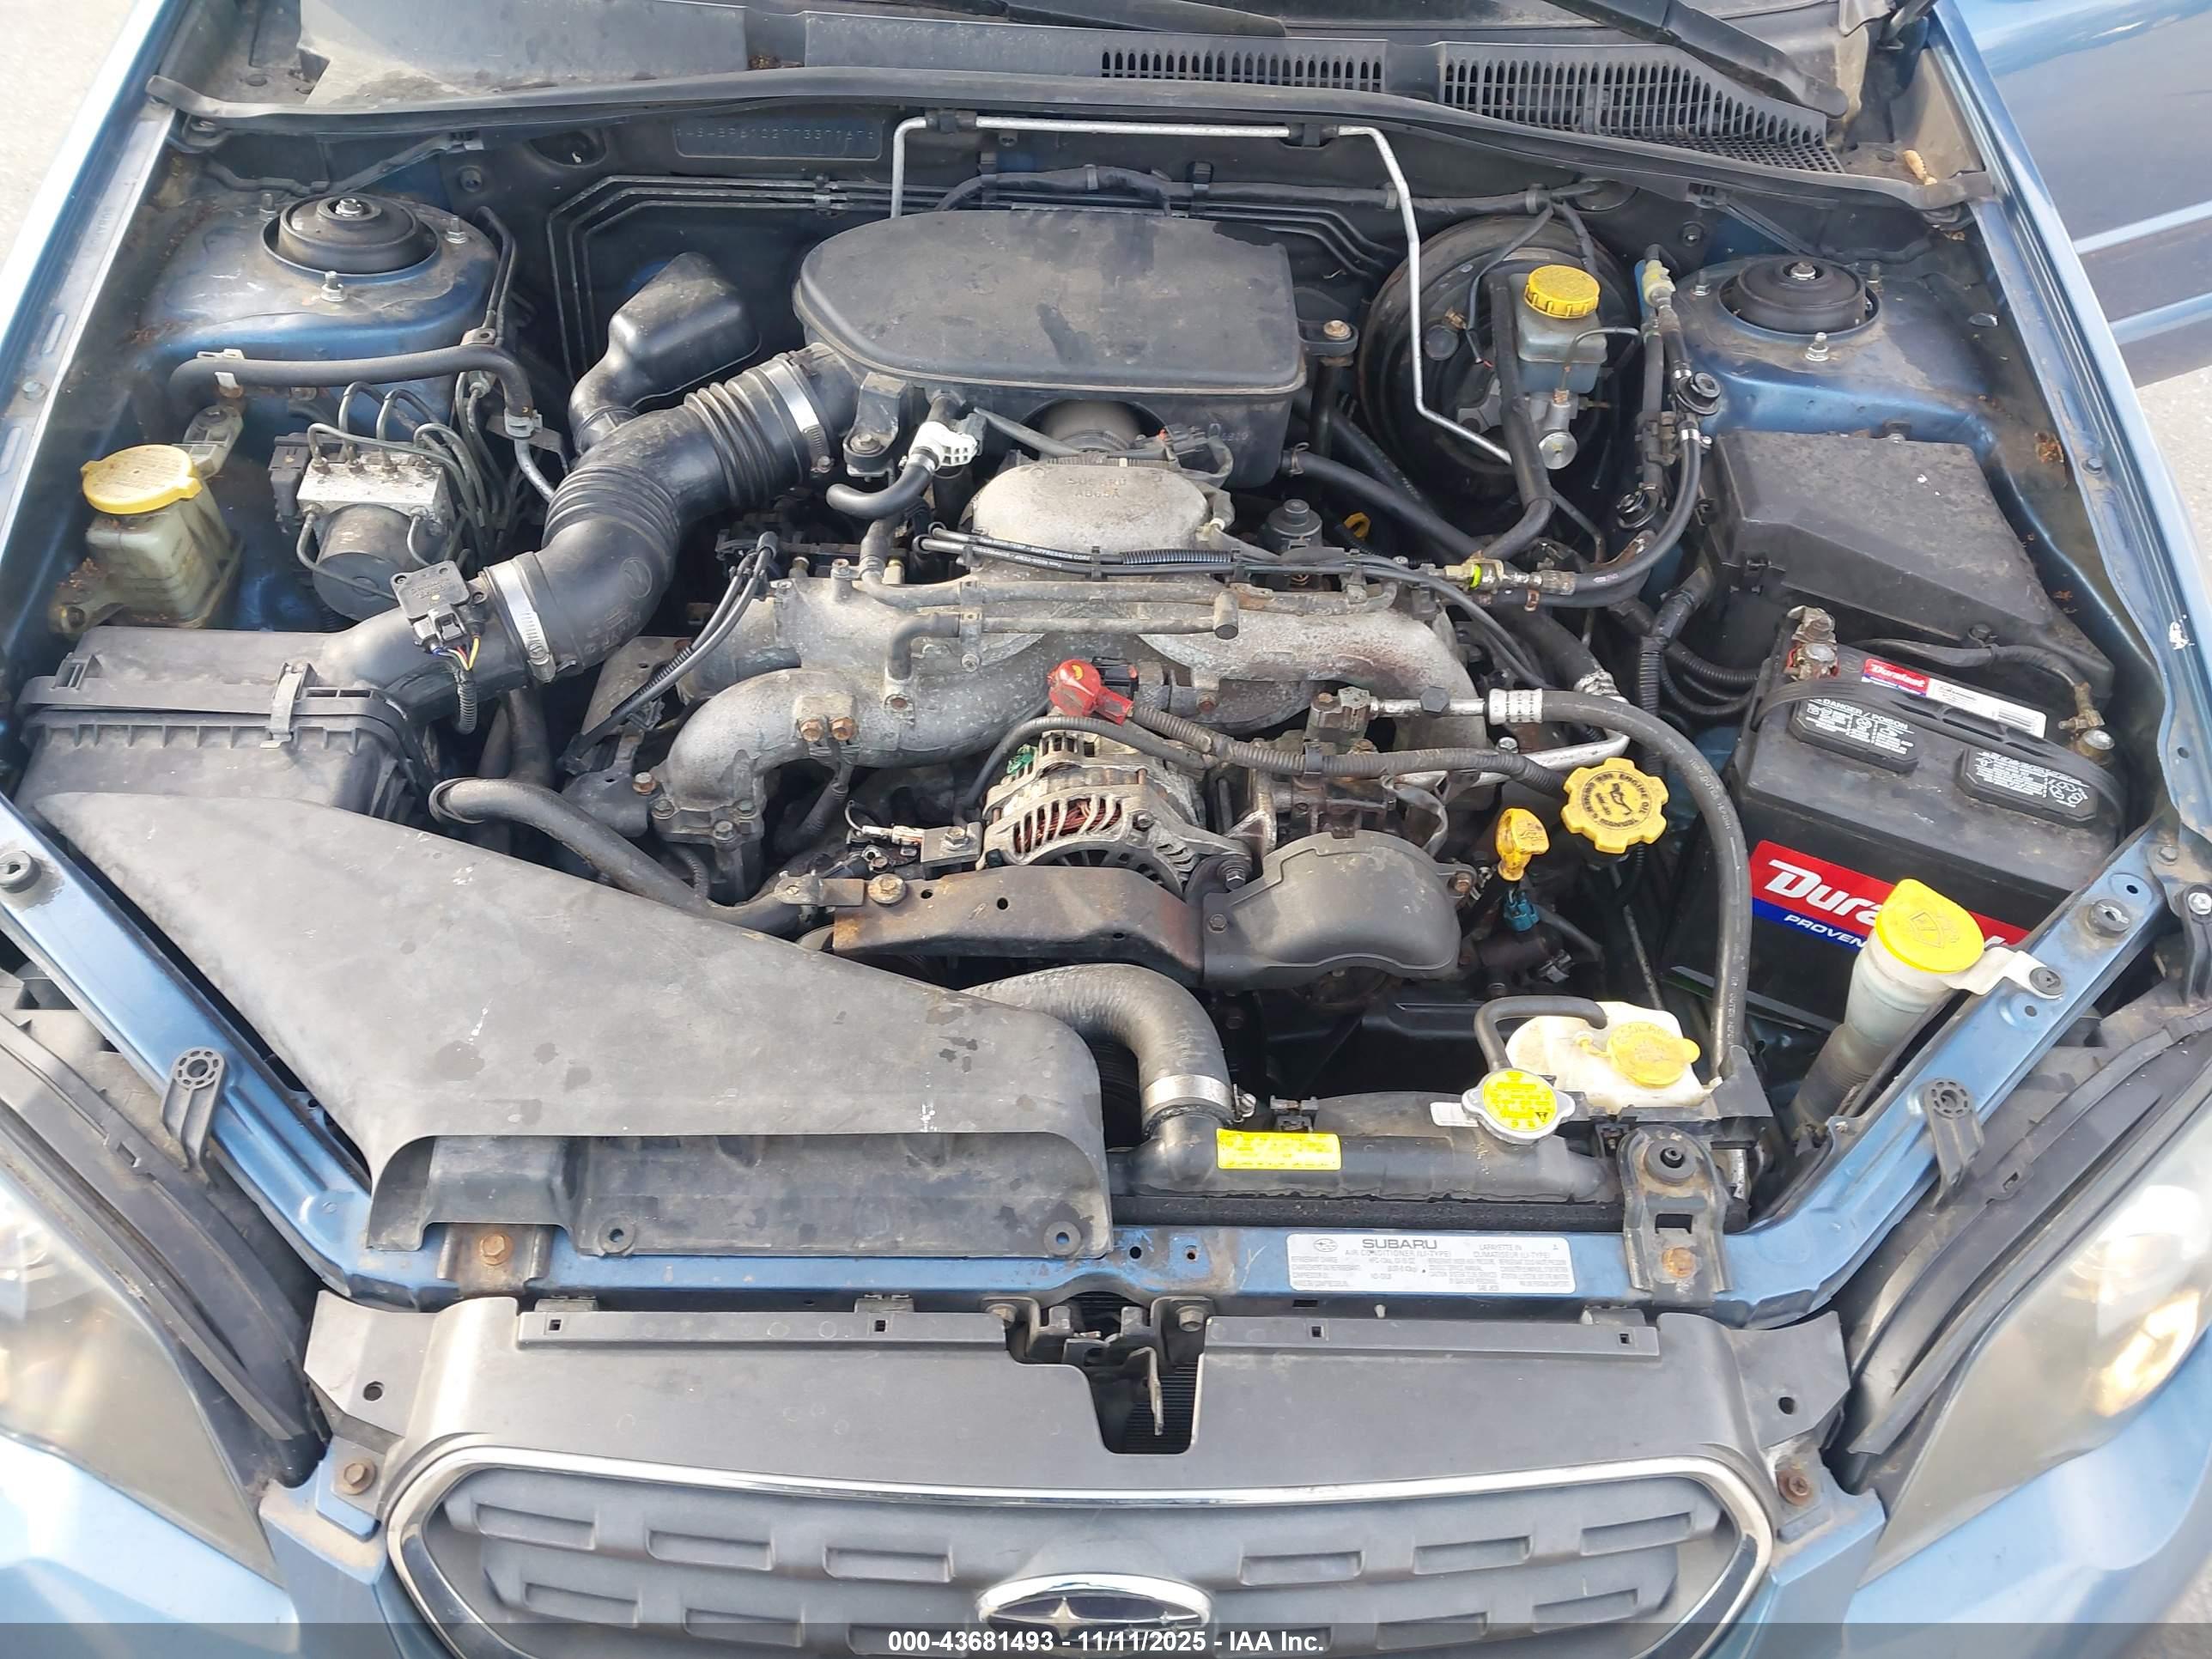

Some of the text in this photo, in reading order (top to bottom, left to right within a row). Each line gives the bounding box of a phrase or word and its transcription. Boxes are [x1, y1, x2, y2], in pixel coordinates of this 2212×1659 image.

[1823, 698, 1863, 715] DANGER
[1871, 713, 1909, 730] POISON
[1362, 1238, 1437, 1249] SUBARU
